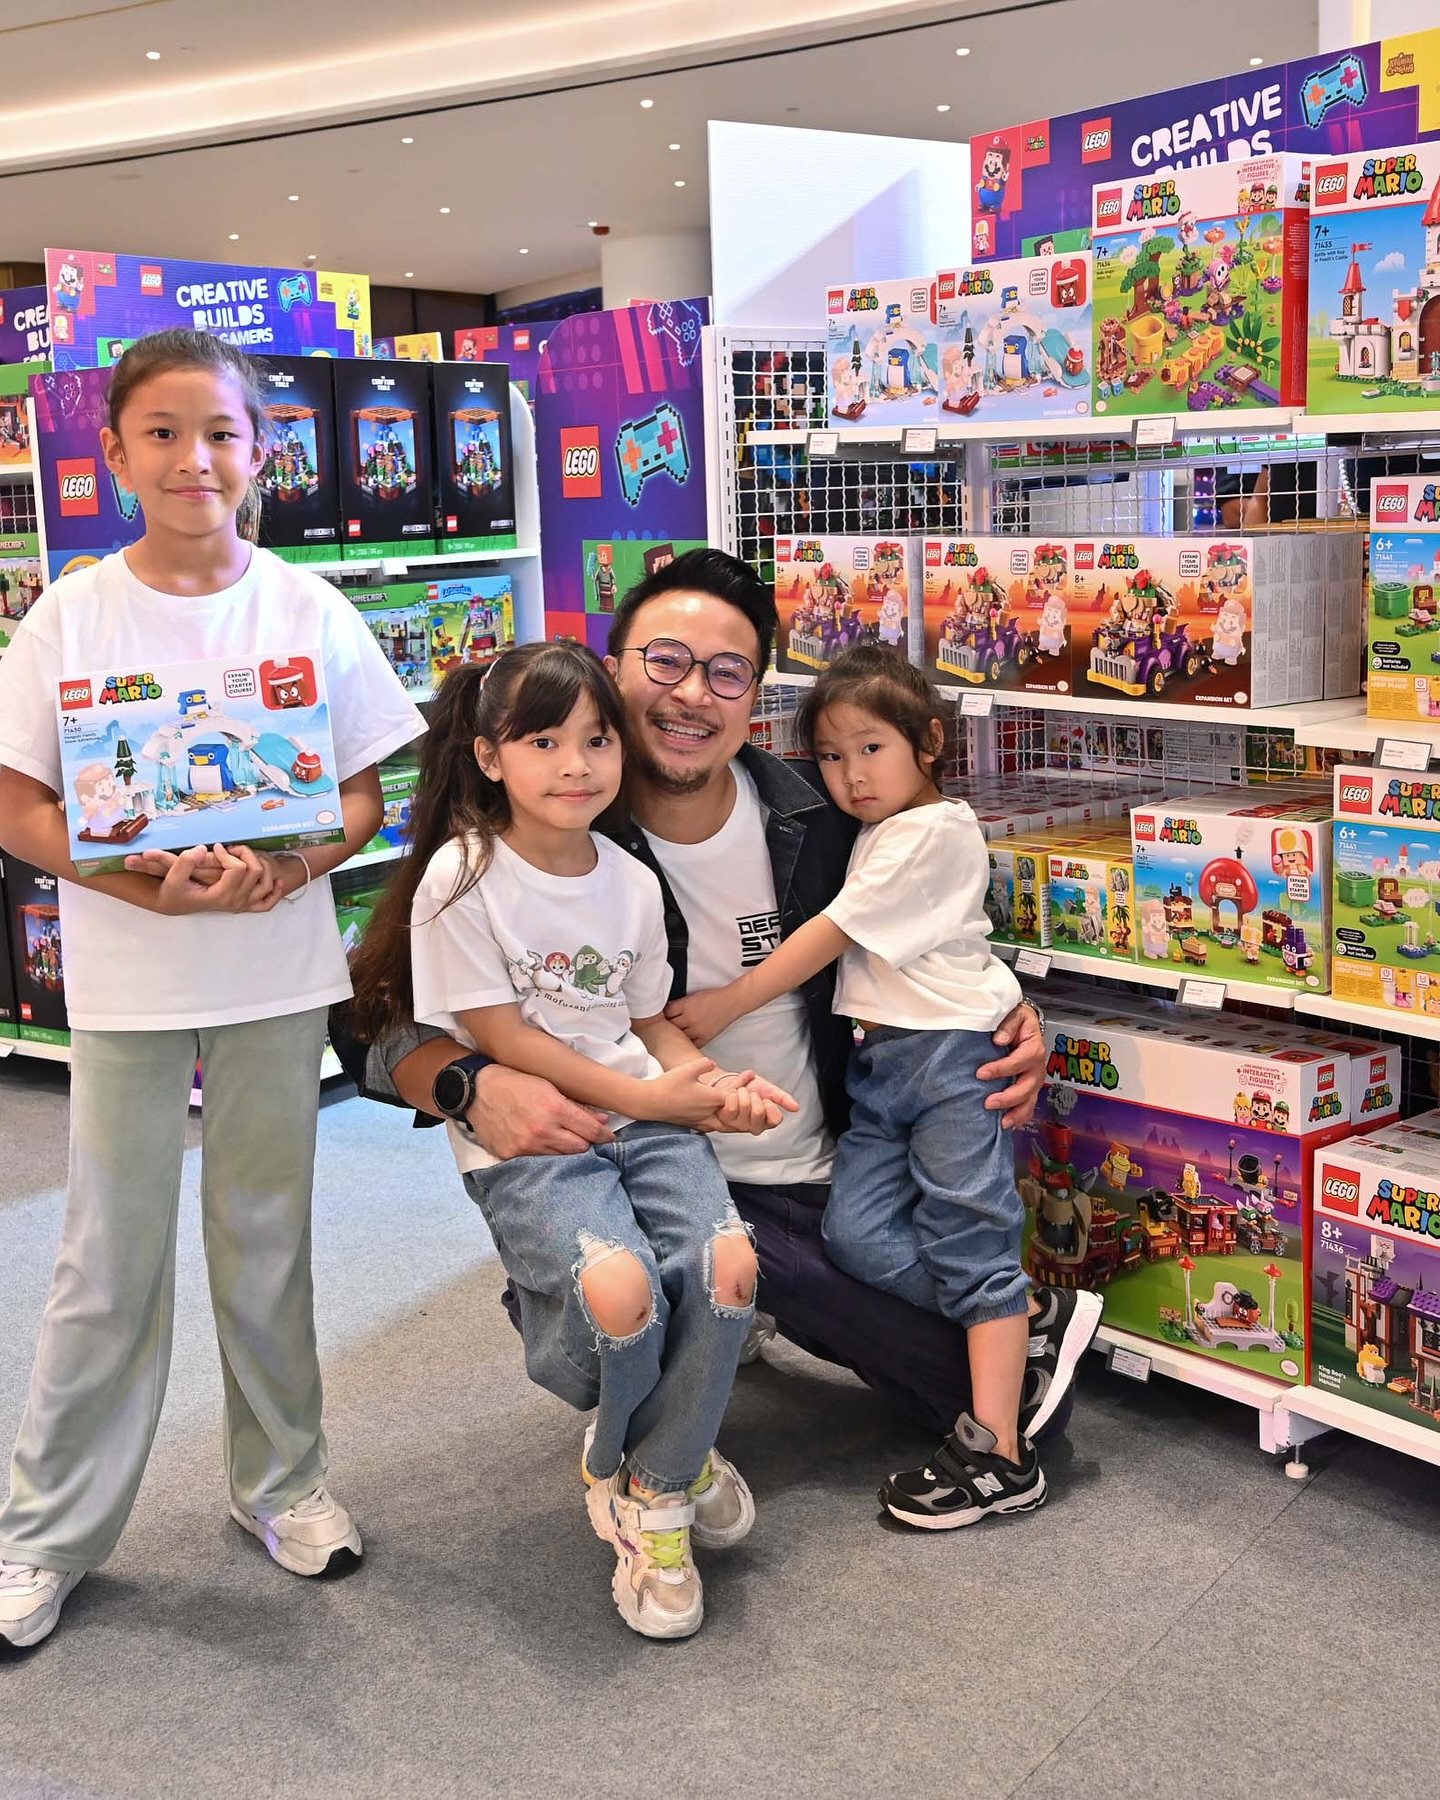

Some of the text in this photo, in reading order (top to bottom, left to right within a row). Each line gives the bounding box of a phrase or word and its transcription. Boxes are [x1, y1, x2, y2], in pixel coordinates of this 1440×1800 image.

[1131, 83, 1282, 167] CREATIVE
[1083, 130, 1110, 152] LEGO
[1362, 153, 1417, 176] SUPER
[1247, 170, 1269, 178] FIGURES
[1134, 179, 1176, 200] SUPER
[1315, 175, 1347, 194] LEGO
[1354, 170, 1423, 200] MARIO
[1098, 199, 1121, 217] LEGO
[1126, 194, 1181, 222] MARIO
[1314, 224, 1330, 240] 7+
[1096, 246, 1109, 259] 7+
[141, 273, 162, 288] LEGO
[962, 268, 991, 282] SUPER
[176, 278, 269, 308] CREATIVE
[850, 287, 876, 299] SUPER
[939, 280, 954, 292] LEGO
[957, 279, 994, 297] MARIO
[846, 296, 879, 312] MARIO
[938, 304, 947, 314] 7+
[192, 303, 265, 331] BUILDS
[828, 318, 836, 327] 7+
[221, 327, 274, 346] GAMERS
[563, 446, 599, 478] LEGO
[61, 473, 96, 500] LEGO
[1377, 495, 1407, 513] LEGO
[797, 540, 822, 550] SUPER
[948, 542, 976, 554] SUPER
[1102, 543, 1135, 556] SUPER
[1375, 537, 1393, 551] 6+
[793, 548, 824, 563] MARIO
[944, 551, 978, 567] MARIO
[1075, 550, 1093, 563] LEGO
[1097, 554, 1139, 570] MARIO
[1375, 553, 1393, 561] 71441
[777, 566, 784, 574] 8+
[925, 570, 934, 579] 8+
[1074, 574, 1085, 584] 8+
[105, 672, 155, 689] SUPER
[227, 671, 251, 679] EXPAND
[62, 686, 91, 703] LEGO
[98, 683, 163, 705] MARIO
[62, 716, 78, 727] 7+
[1340, 784, 1371, 804] LEGO
[1388, 779, 1440, 800] SUPER
[261, 820, 315, 834] EXPANSION SET
[1136, 821, 1154, 834] LEGO
[1163, 816, 1198, 831] SUPER
[1159, 827, 1203, 846] MARIO
[1339, 826, 1357, 839] 6+
[1136, 844, 1146, 853] 7+
[1339, 841, 1357, 850] 71441
[1067, 861, 1087, 871] SUPER
[1064, 868, 1090, 881] MARIO
[1347, 945, 1366, 953] batteries
[1355, 951, 1374, 959] included
[1266, 976, 1295, 985] EXPANSION
[1054, 1033, 1111, 1063] SUPER
[1046, 1050, 1119, 1091] MARIO
[1242, 1067, 1281, 1080] INTERACTIVE
[1371, 1062, 1386, 1075] LEGO
[1248, 1075, 1275, 1086] FIGURES
[1318, 1071, 1334, 1083] LEGO
[1364, 1083, 1390, 1099] SUPER
[1312, 1091, 1339, 1107] SUPER
[1359, 1091, 1394, 1114] MARIO
[1308, 1100, 1342, 1123] MARIO
[1322, 1177, 1359, 1202] LEGO
[1378, 1179, 1440, 1212] SUPER
[1366, 1195, 1440, 1239] MARIO
[1321, 1221, 1342, 1239] 8+
[1320, 1240, 1344, 1255] 71436
[1318, 1364, 1346, 1379] King Boo's
[1318, 1370, 1341, 1384] Haunted
[1318, 1377, 1340, 1389] Mansion
